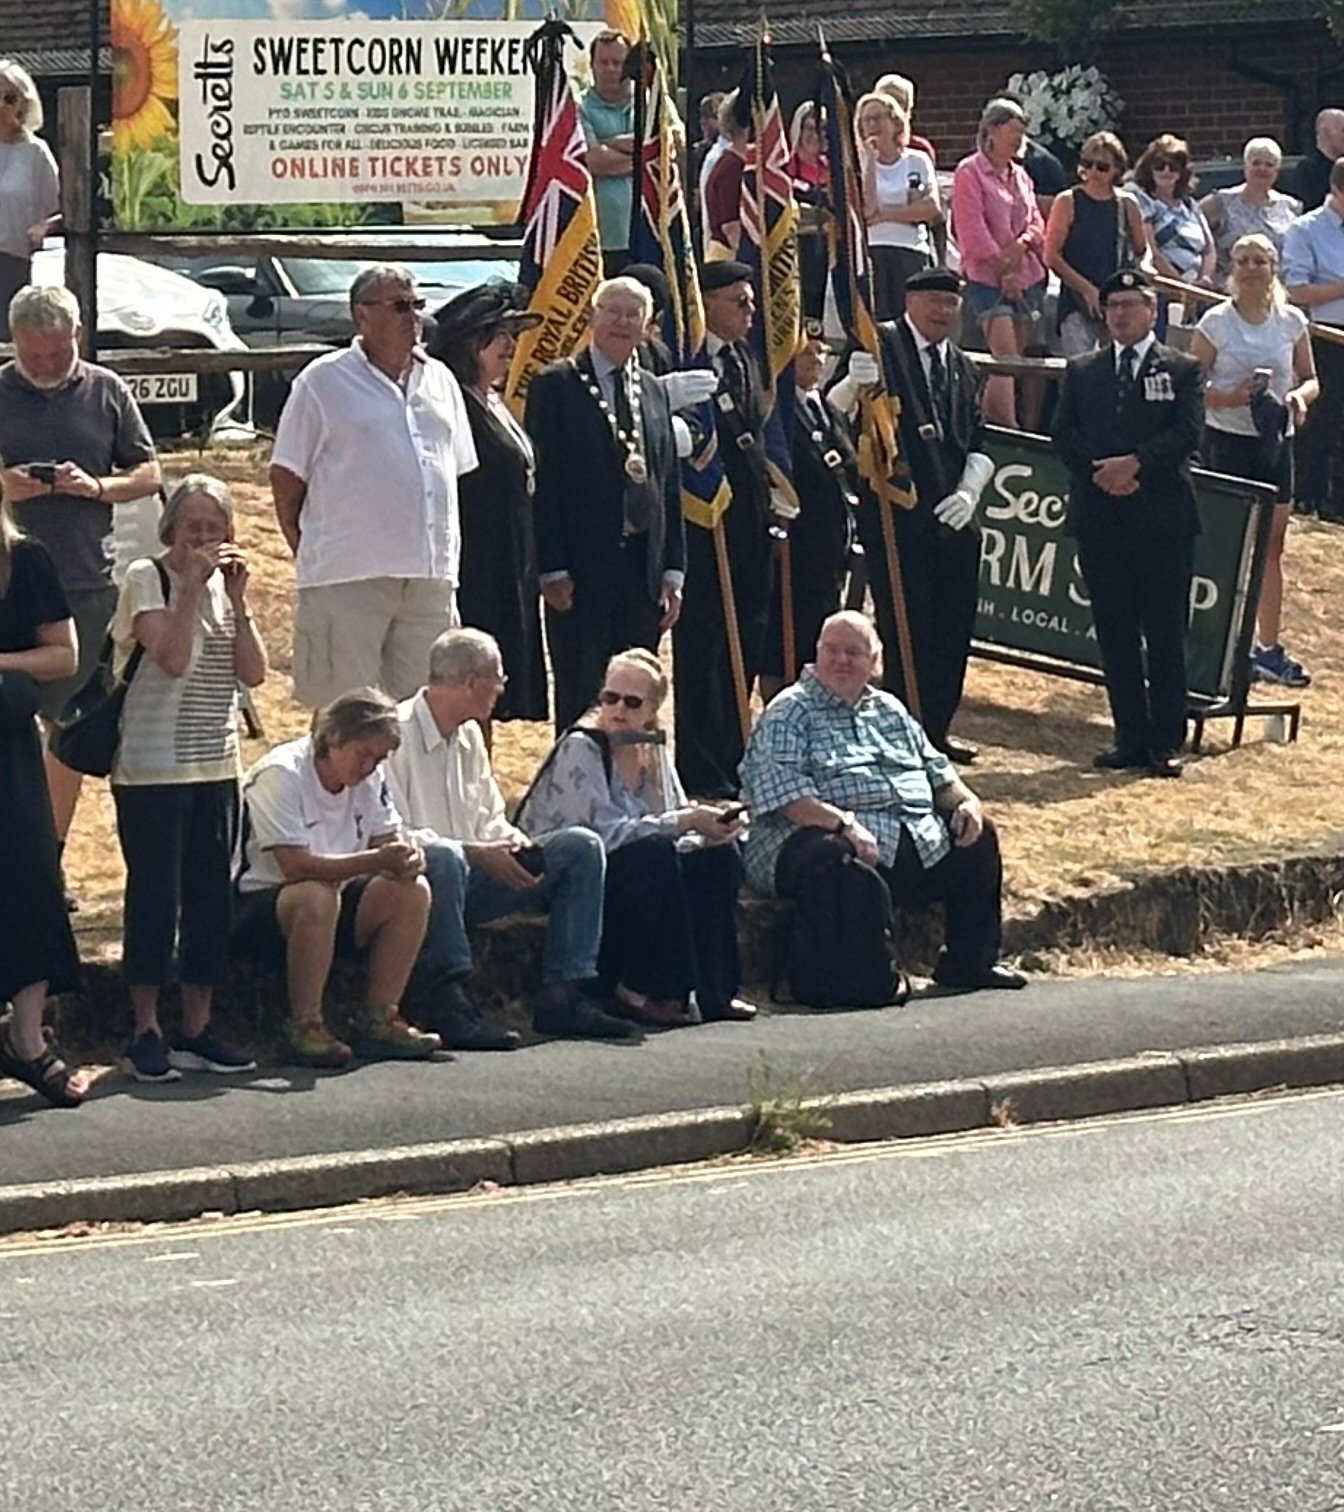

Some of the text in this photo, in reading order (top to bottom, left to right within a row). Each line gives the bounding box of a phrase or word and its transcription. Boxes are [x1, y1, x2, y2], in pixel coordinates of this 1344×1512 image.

[252, 35, 548, 76] SWEETCORN WEEKEN
[279, 80, 321, 101] SAT
[339, 80, 351, 100] &
[357, 81, 393, 100] SUN
[398, 80, 408, 100] 6
[413, 80, 513, 100] SEPTEMBER
[193, 33, 236, 191] Secretts
[321, 139, 342, 151] FOR
[425, 138, 456, 150] FOOD
[271, 154, 528, 179] ONLINE TICKETS ONLY
[531, 306, 572, 365] ROYAL
[154, 377, 190, 399] ZGU
[1011, 606, 1070, 634] LOCAL
